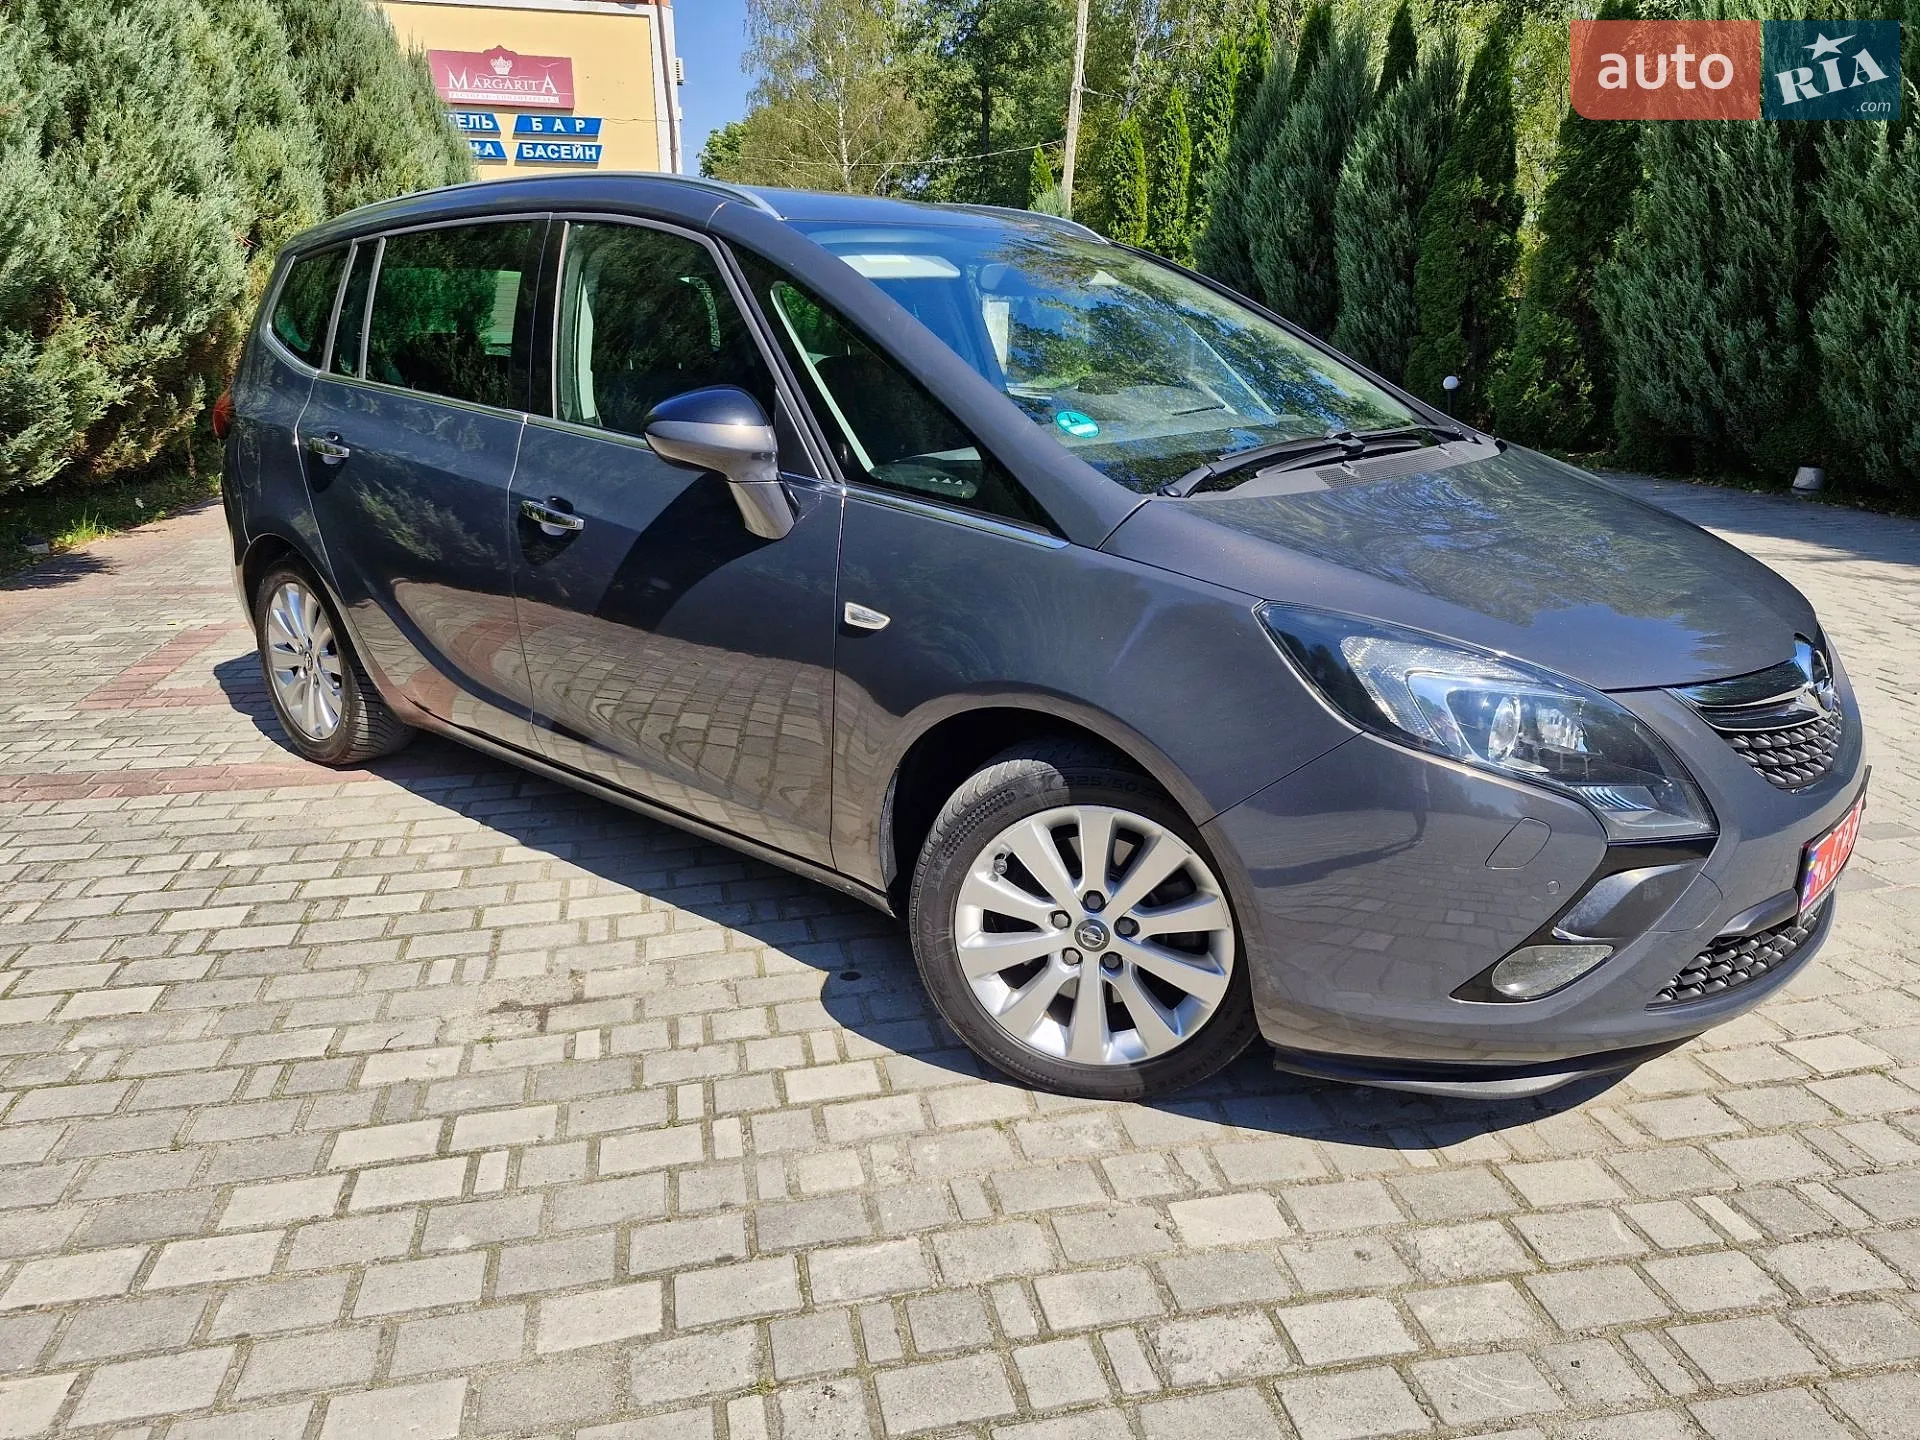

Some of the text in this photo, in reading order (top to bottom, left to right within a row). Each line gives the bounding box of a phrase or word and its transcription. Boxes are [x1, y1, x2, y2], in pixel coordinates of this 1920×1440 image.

[447, 66, 557, 94] MARGARITA
[531, 117, 586, 132] БАР
[522, 143, 597, 160] БАСЕЙН
